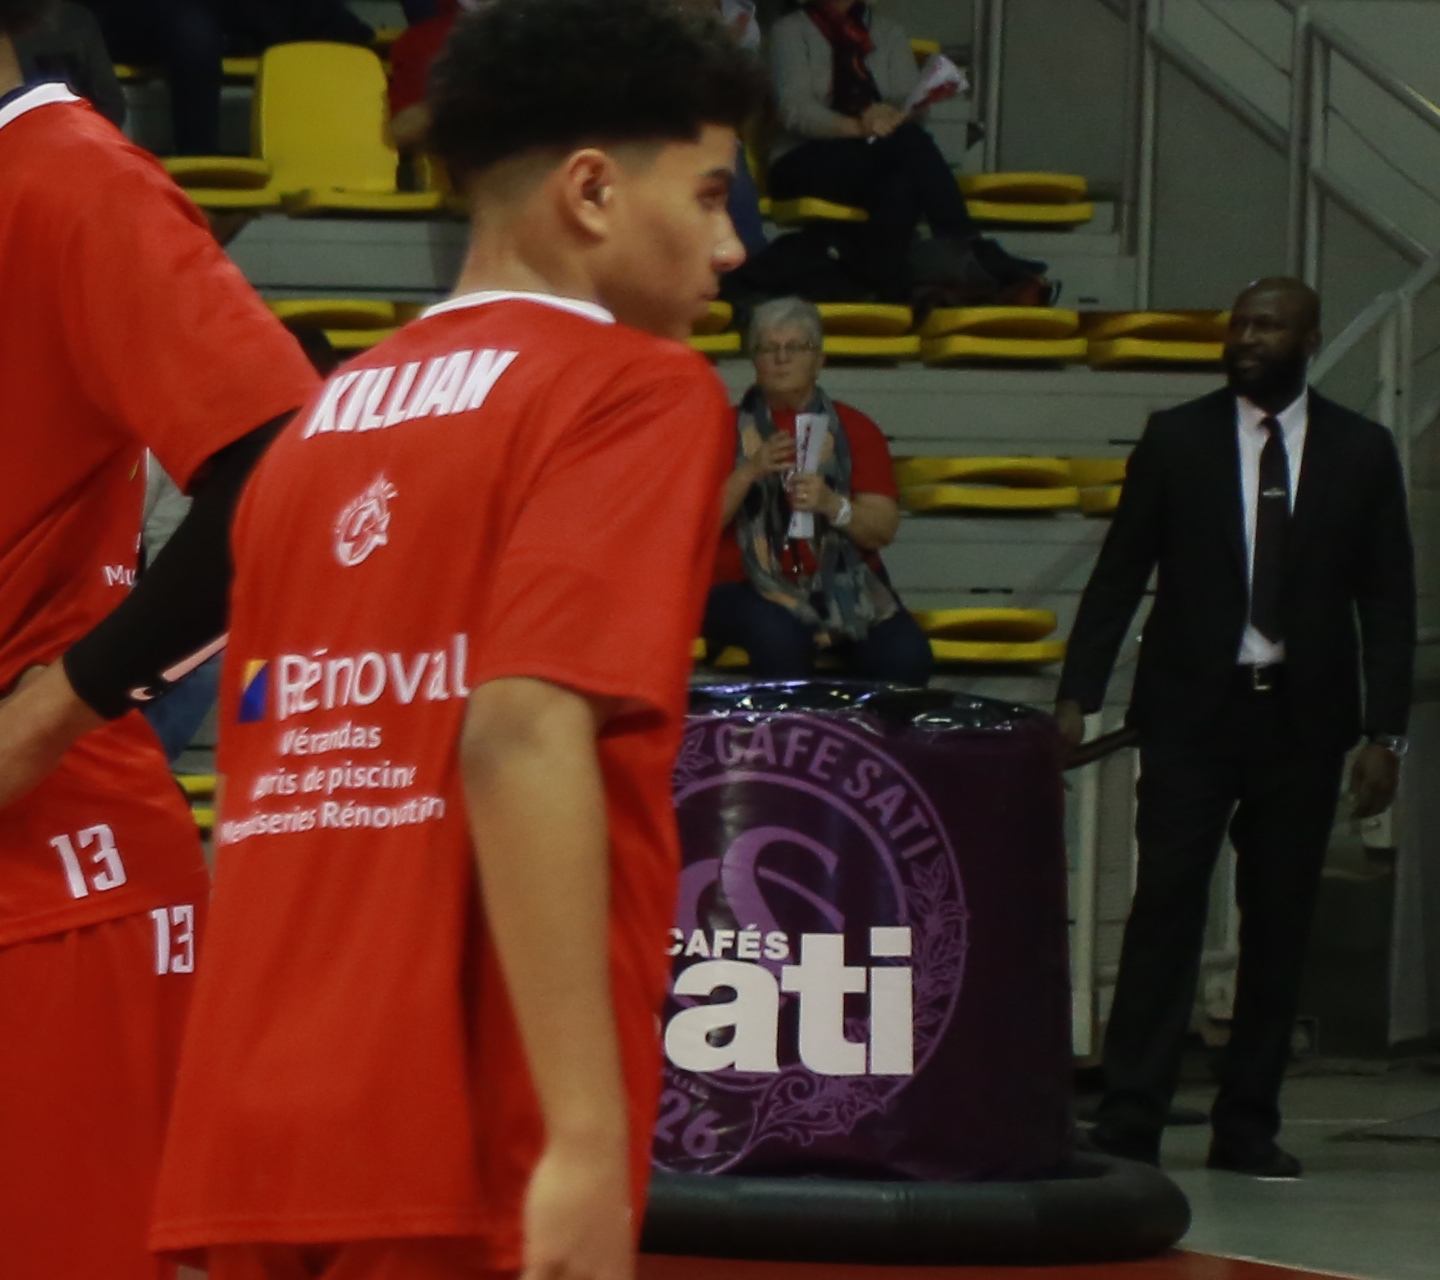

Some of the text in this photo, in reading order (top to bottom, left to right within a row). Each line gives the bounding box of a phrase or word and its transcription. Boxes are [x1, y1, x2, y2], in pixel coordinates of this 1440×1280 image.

[302, 347, 520, 441] KILLIAN
[276, 631, 472, 723] Rénoval
[842, 753, 942, 862] SATI
[48, 823, 127, 899] 13
[150, 904, 196, 976] 13
